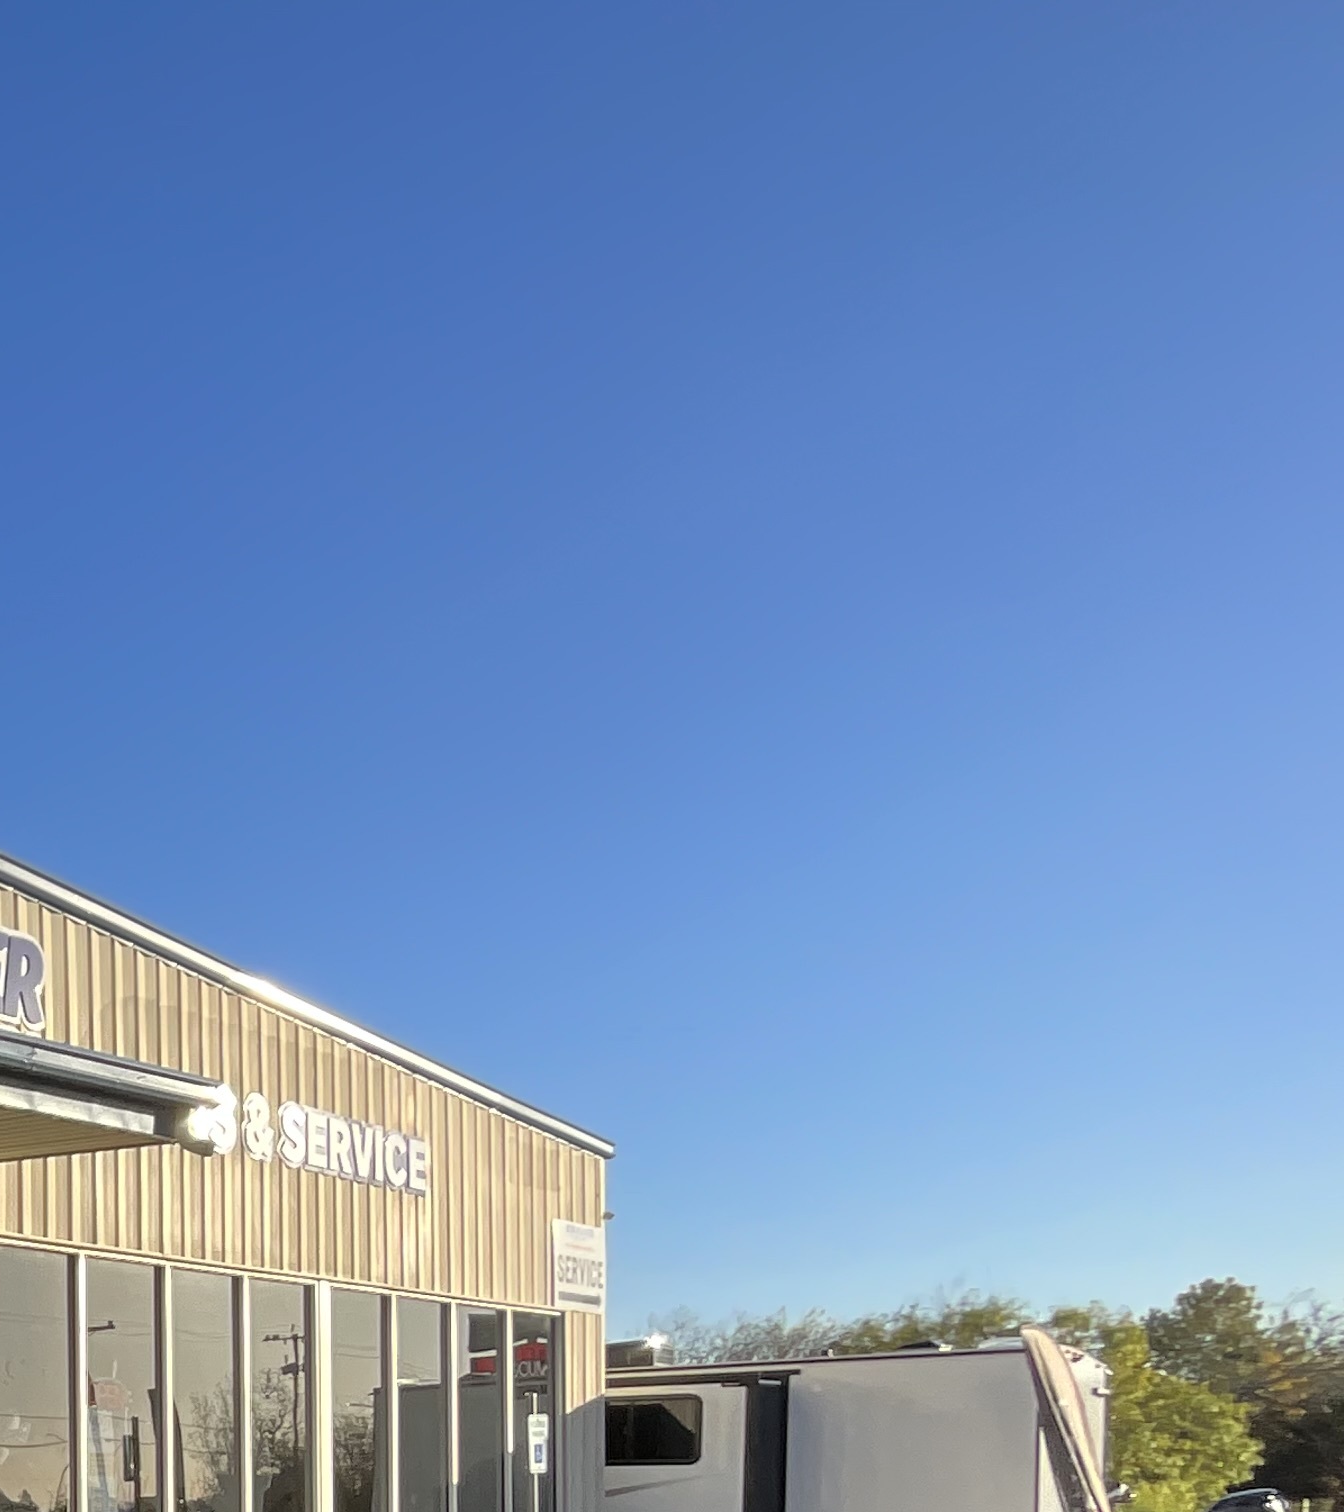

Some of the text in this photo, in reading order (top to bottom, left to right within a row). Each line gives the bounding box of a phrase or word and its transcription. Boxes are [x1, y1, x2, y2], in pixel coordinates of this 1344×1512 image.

[242, 1092, 274, 1162] &
[278, 1101, 427, 1197] SERVICE
[557, 1254, 604, 1289] SERVICE
